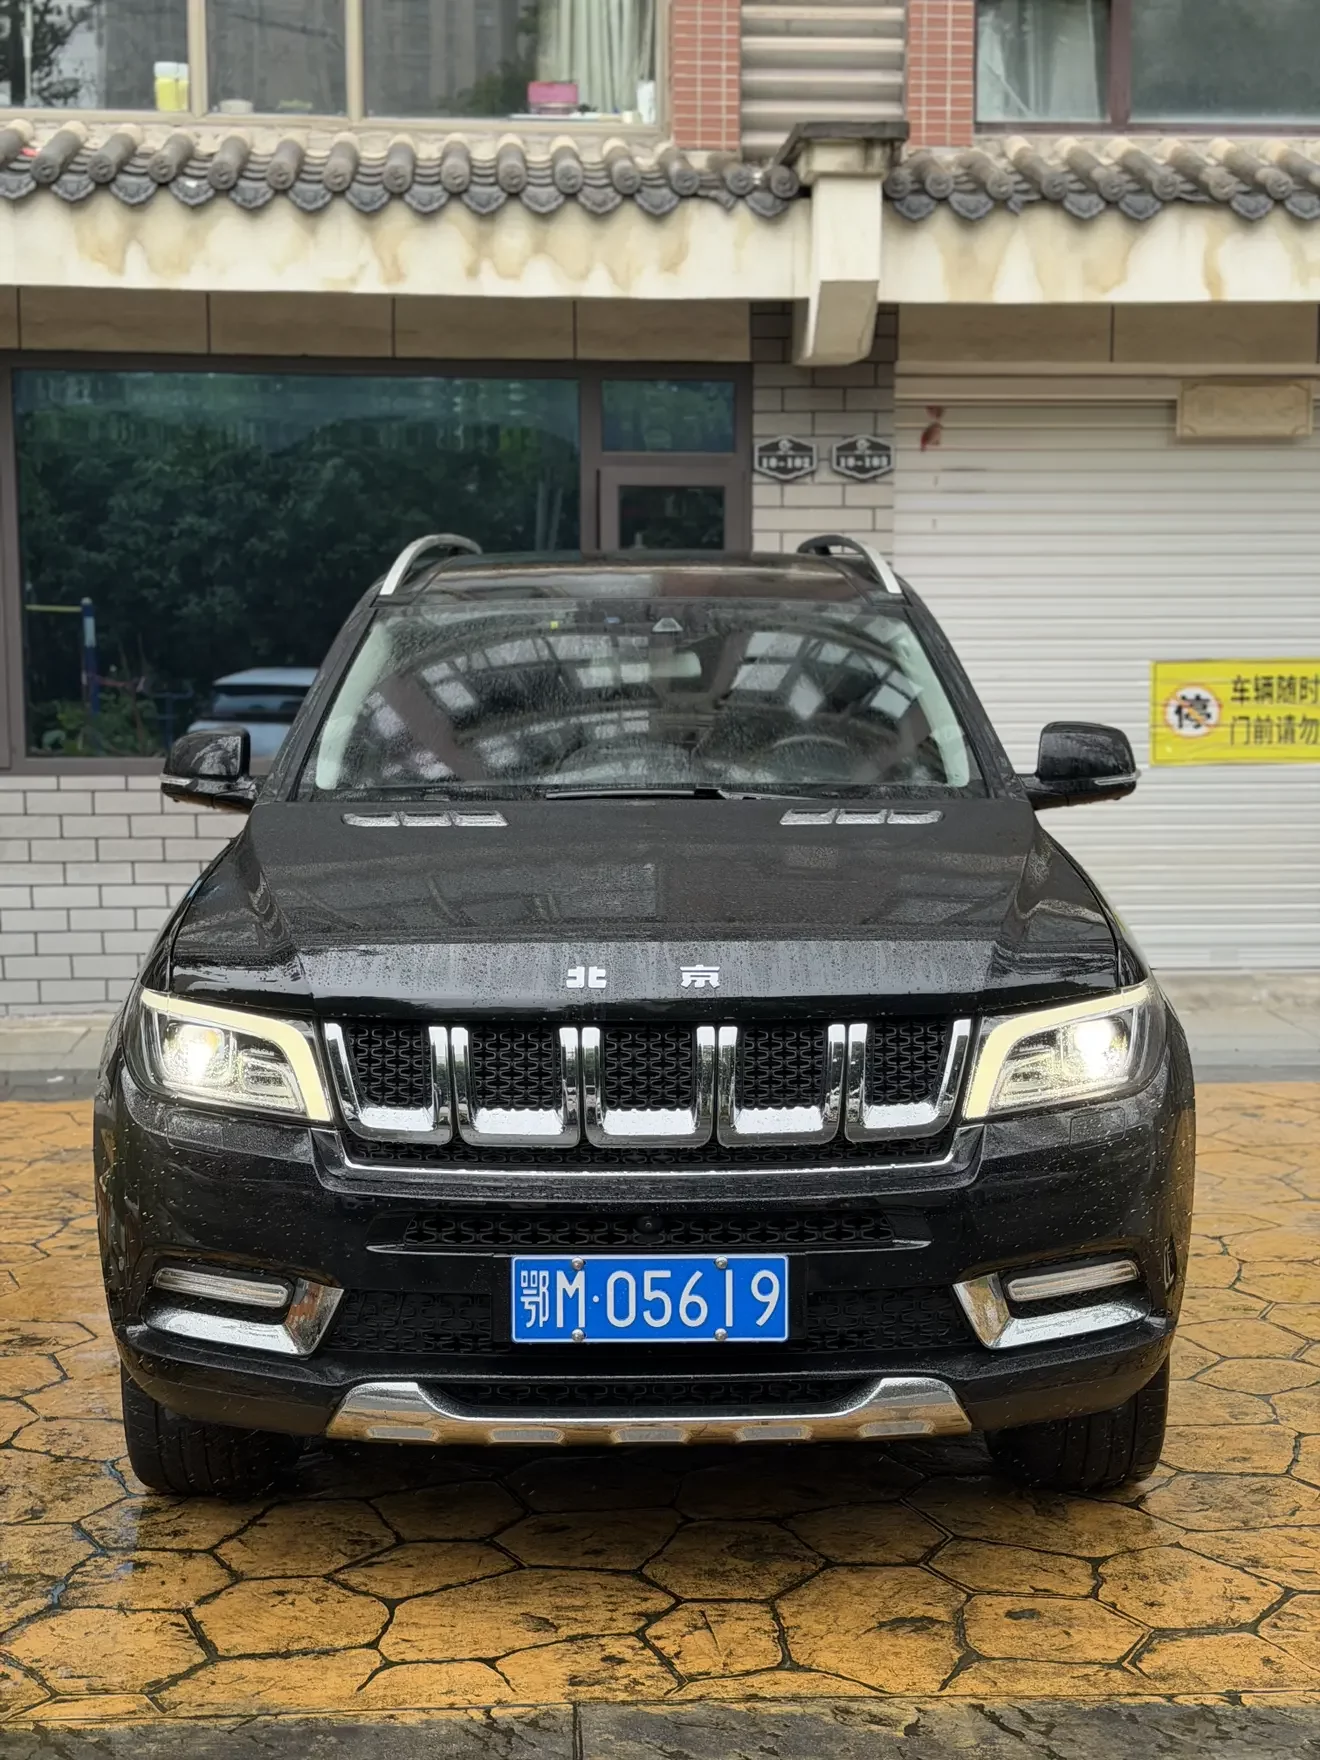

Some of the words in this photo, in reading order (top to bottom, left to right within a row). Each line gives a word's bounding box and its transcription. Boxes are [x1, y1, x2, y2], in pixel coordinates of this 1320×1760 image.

[1231, 675, 1320, 705] 车辆随时
[1230, 714, 1320, 746] 门前请勿
